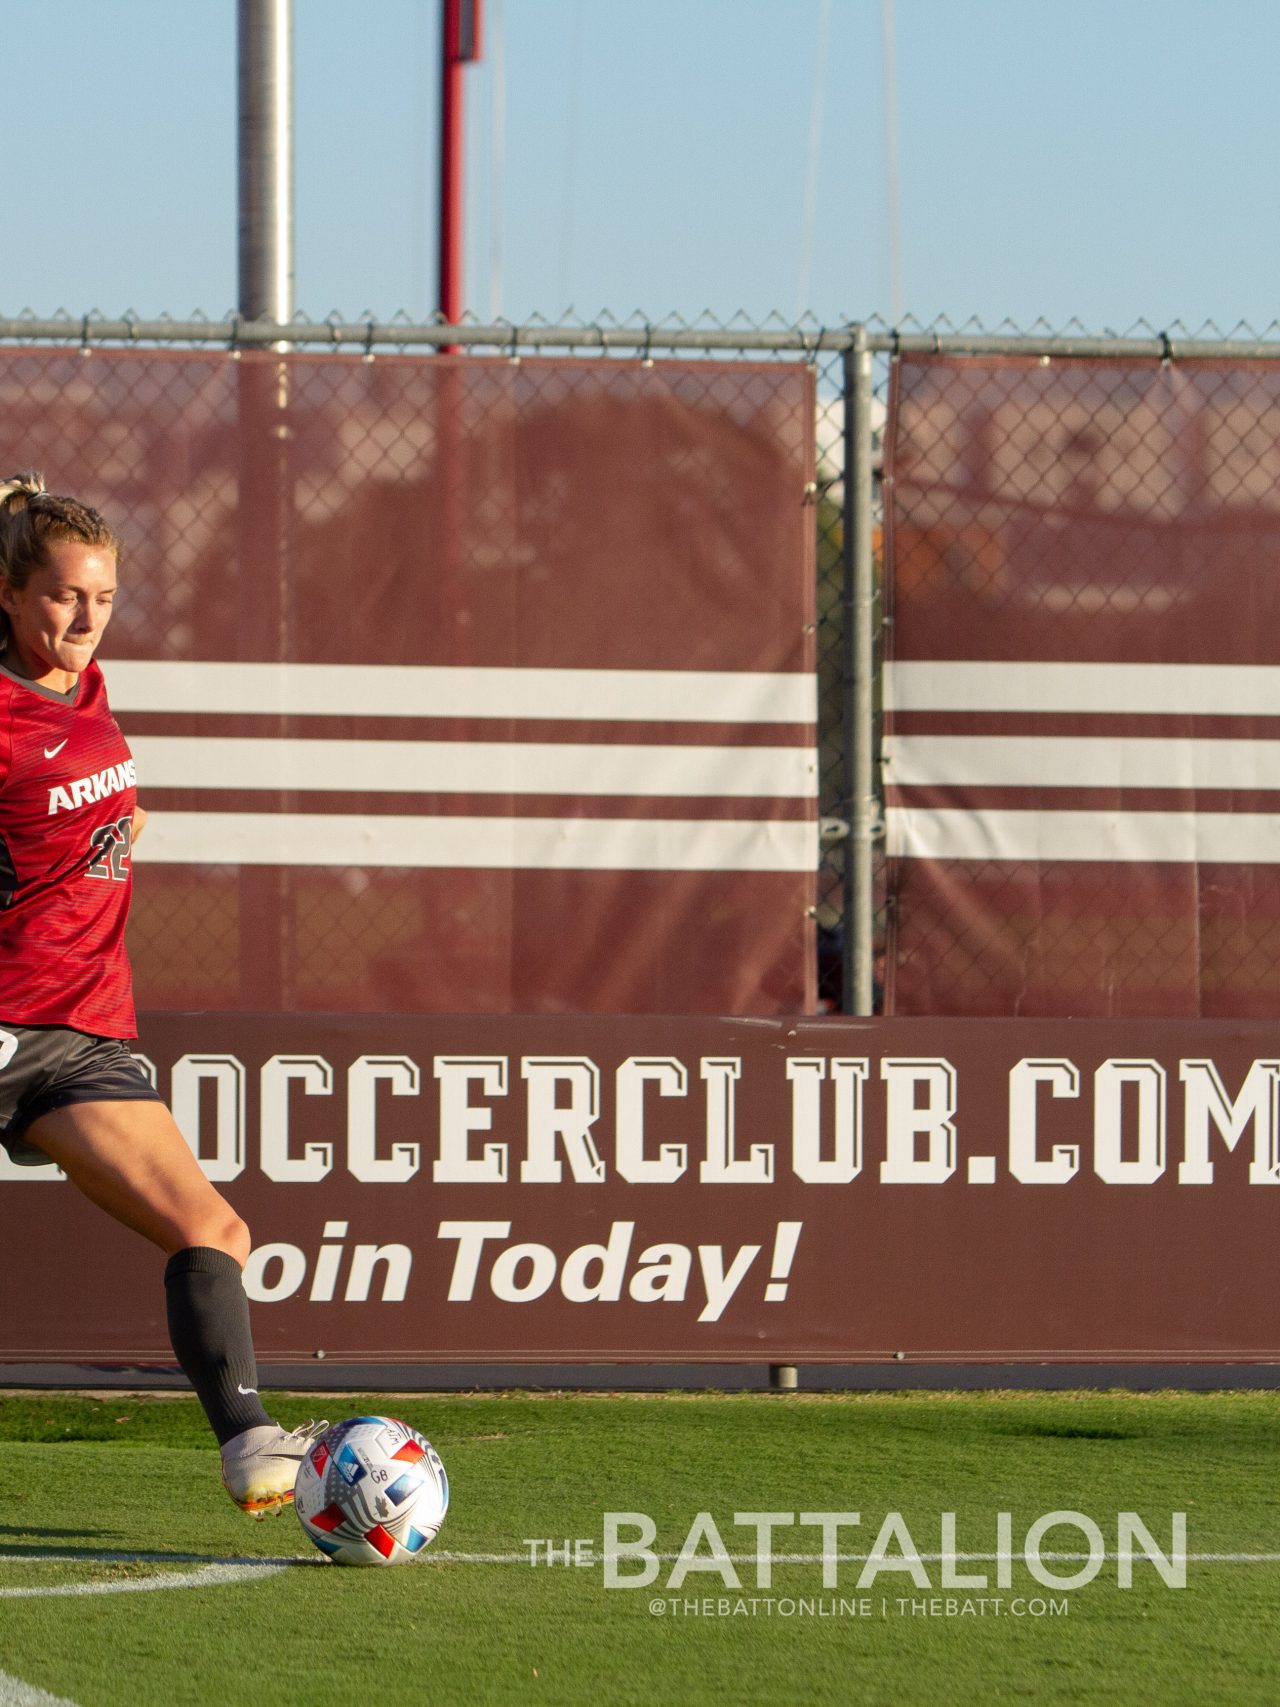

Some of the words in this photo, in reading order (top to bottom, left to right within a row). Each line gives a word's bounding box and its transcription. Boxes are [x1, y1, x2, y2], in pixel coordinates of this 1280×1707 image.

[84, 816, 132, 881] 22
[242, 1221, 412, 1302] oin
[437, 1221, 803, 1322] Today!
[371, 1469, 388, 1484] GB
